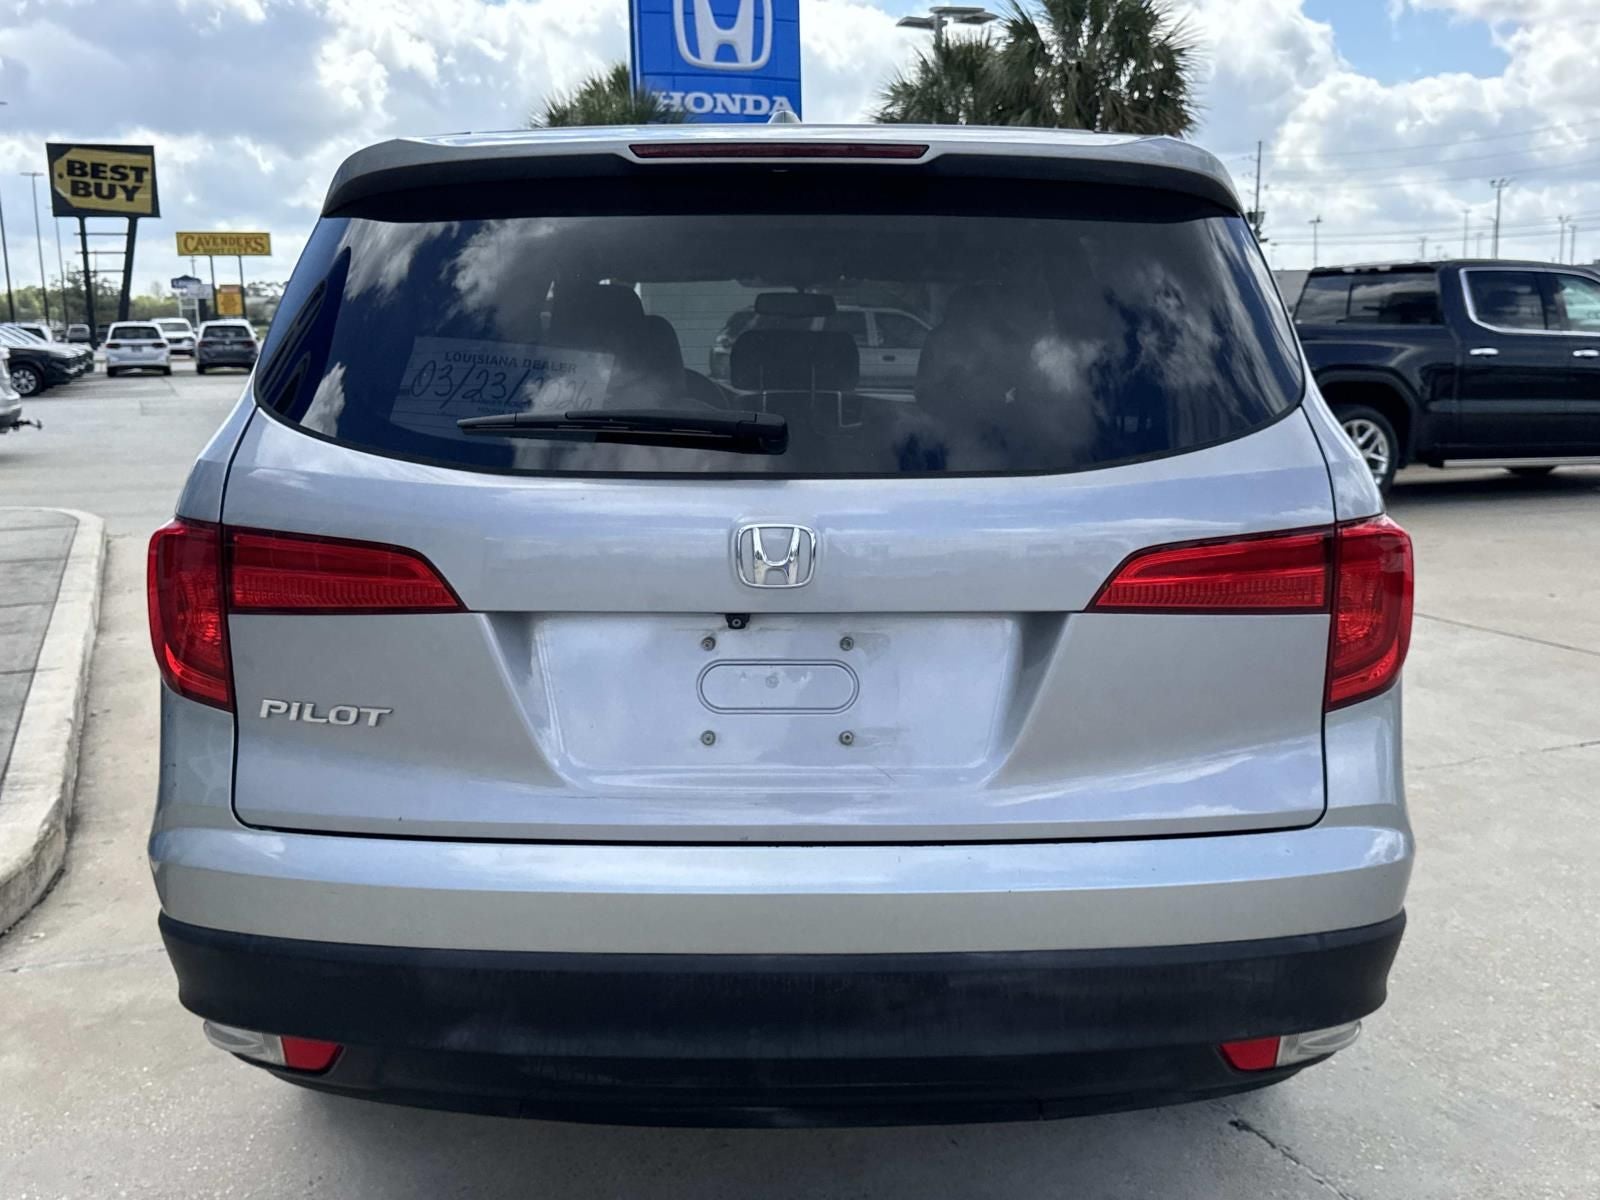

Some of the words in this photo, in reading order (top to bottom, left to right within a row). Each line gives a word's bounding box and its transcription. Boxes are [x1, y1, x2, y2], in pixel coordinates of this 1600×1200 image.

[652, 91, 793, 116] HONDA
[66, 159, 149, 183] BEST
[70, 180, 142, 202] BUY
[444, 351, 518, 369] LOUISIANA
[523, 358, 577, 374] DEALER
[259, 698, 393, 727] PILOT
